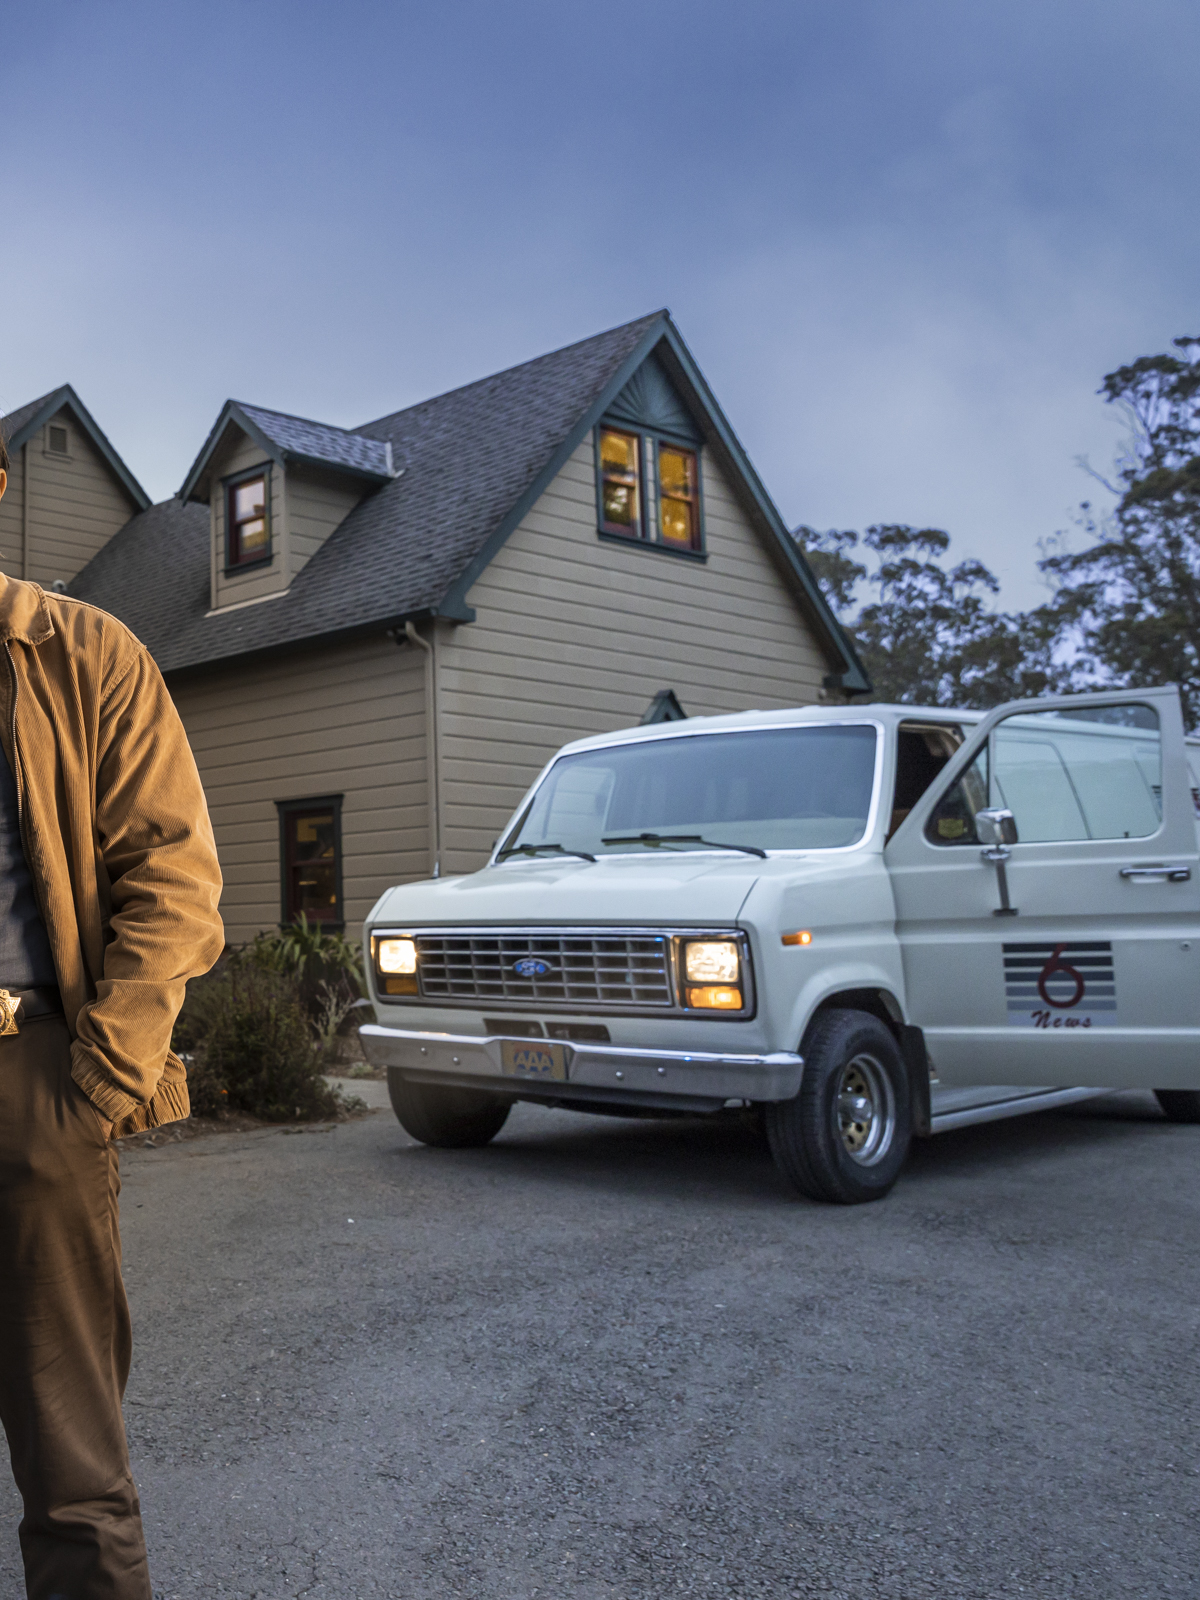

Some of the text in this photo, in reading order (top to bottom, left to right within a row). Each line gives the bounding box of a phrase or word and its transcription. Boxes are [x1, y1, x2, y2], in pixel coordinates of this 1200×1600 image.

[1038, 943, 1084, 1008] 6
[1031, 1010, 1092, 1028] News
[515, 1050, 552, 1071] AAA
